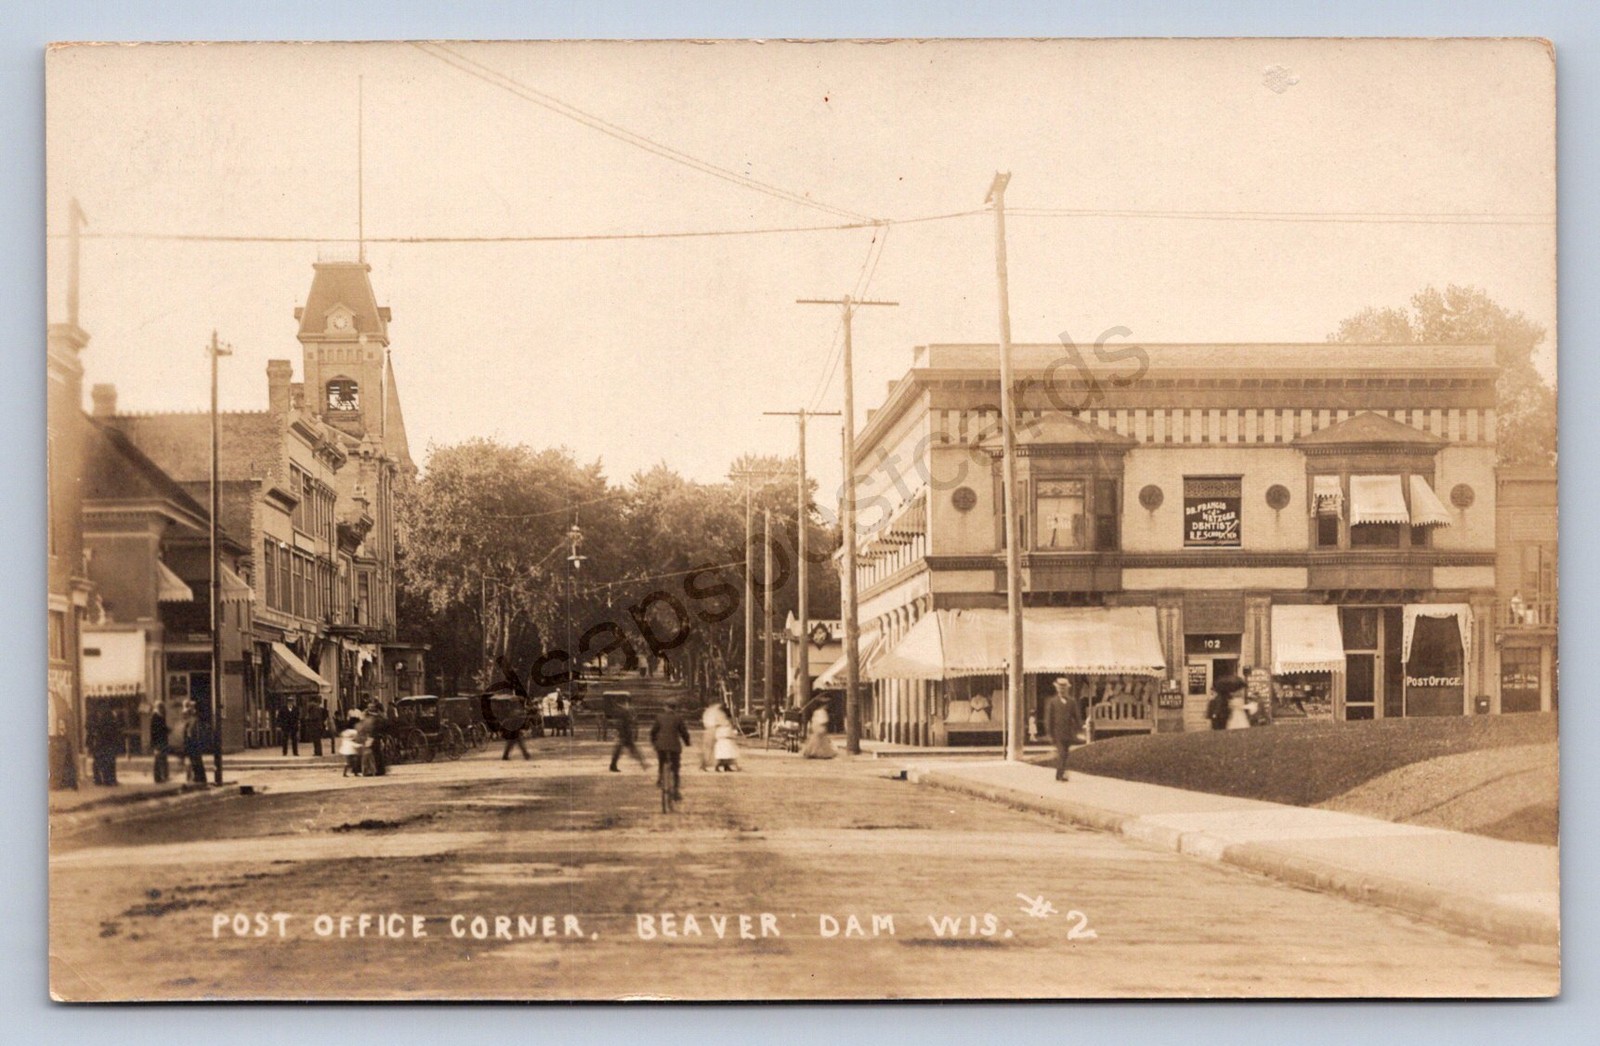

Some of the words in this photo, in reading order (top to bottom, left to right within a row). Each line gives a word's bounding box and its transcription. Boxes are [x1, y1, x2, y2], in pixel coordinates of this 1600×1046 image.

[1192, 521, 1232, 530] DENTIST
[1204, 640, 1221, 648] 102
[1406, 676, 1429, 687] POST
